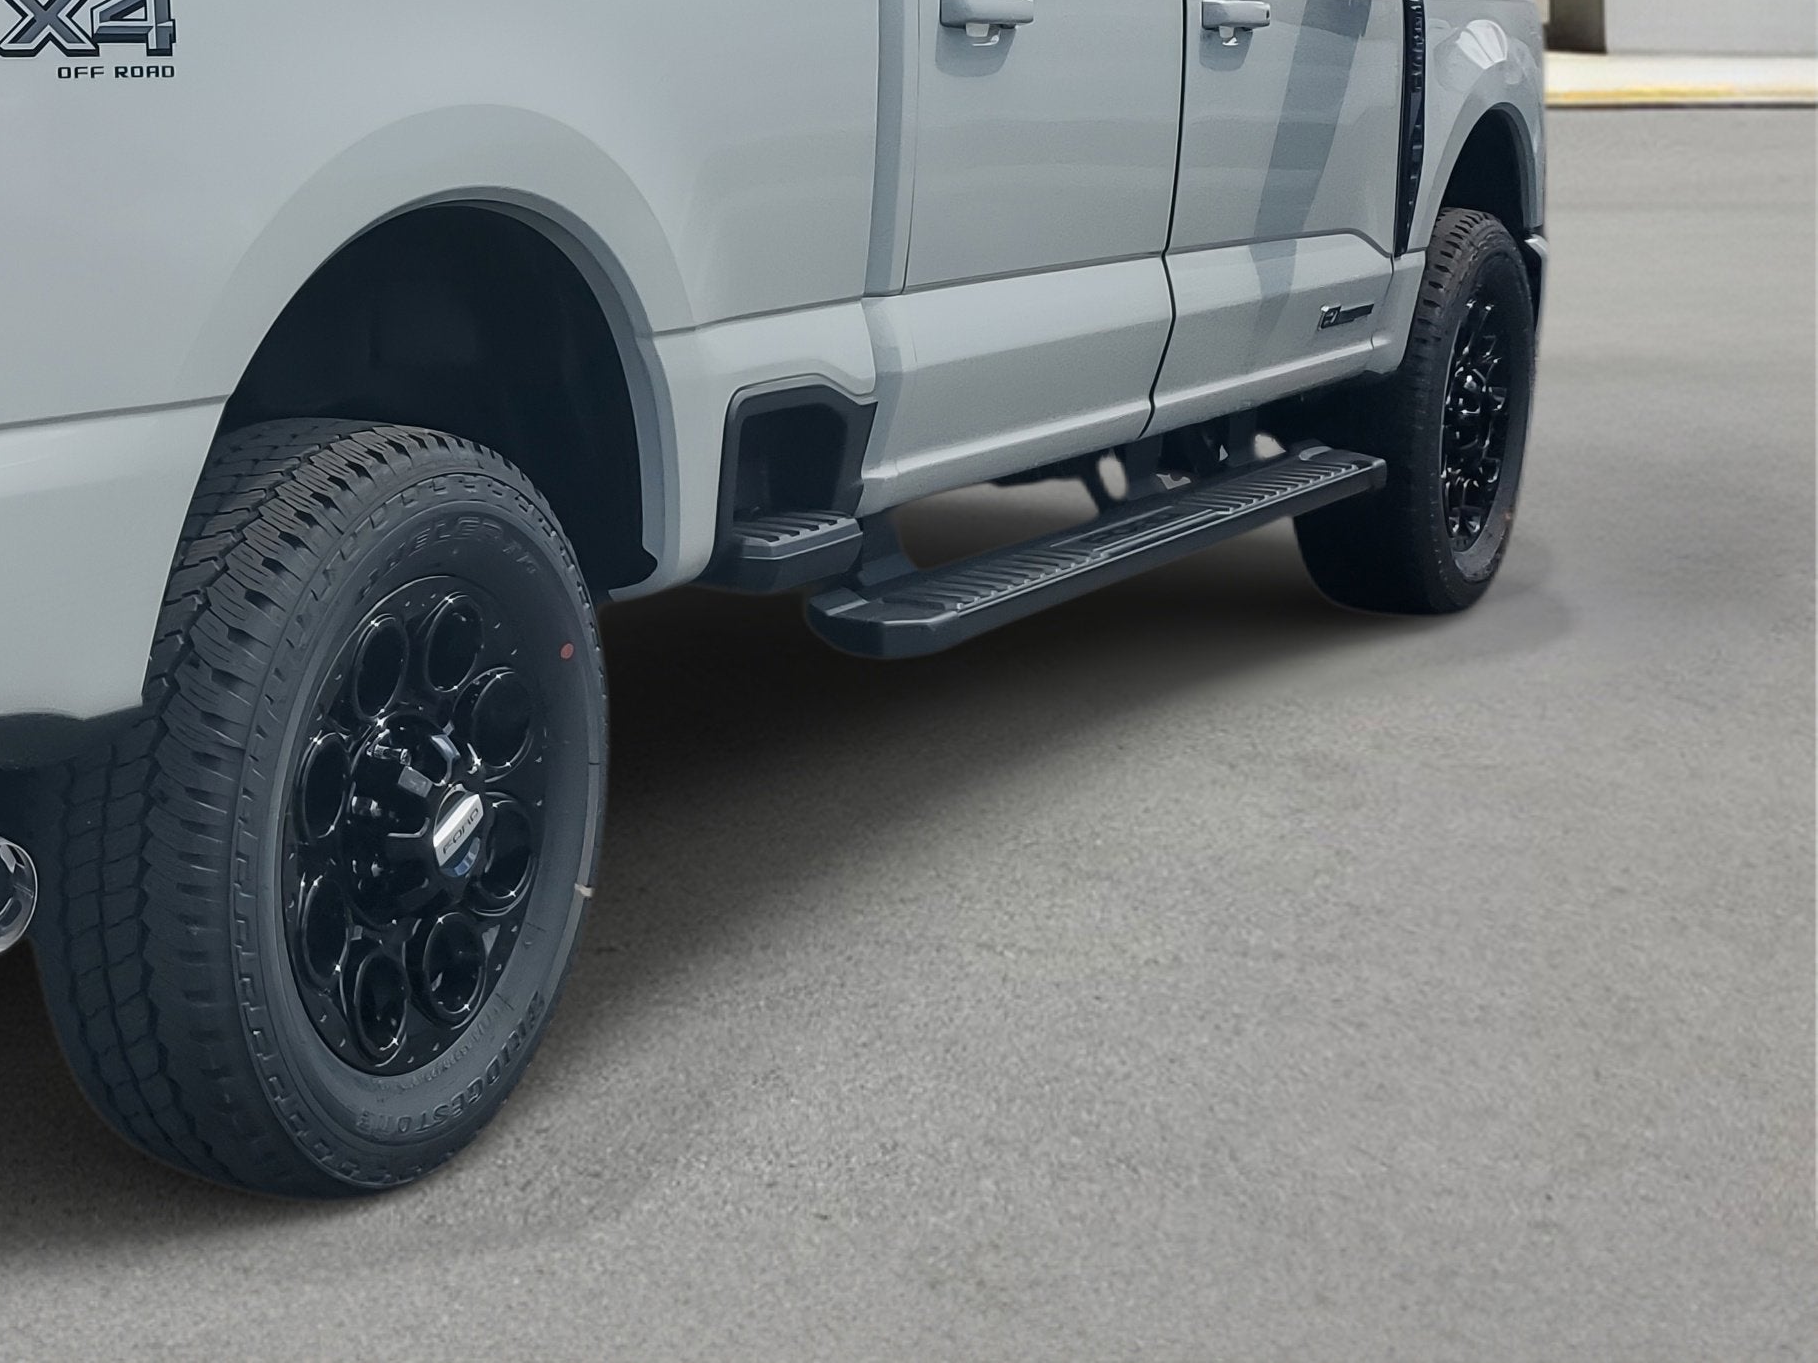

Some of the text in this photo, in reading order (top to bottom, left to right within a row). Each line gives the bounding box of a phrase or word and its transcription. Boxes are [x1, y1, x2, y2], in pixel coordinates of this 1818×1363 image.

[57, 65, 175, 79] OFF ROAD
[442, 807, 480, 855] FORD
